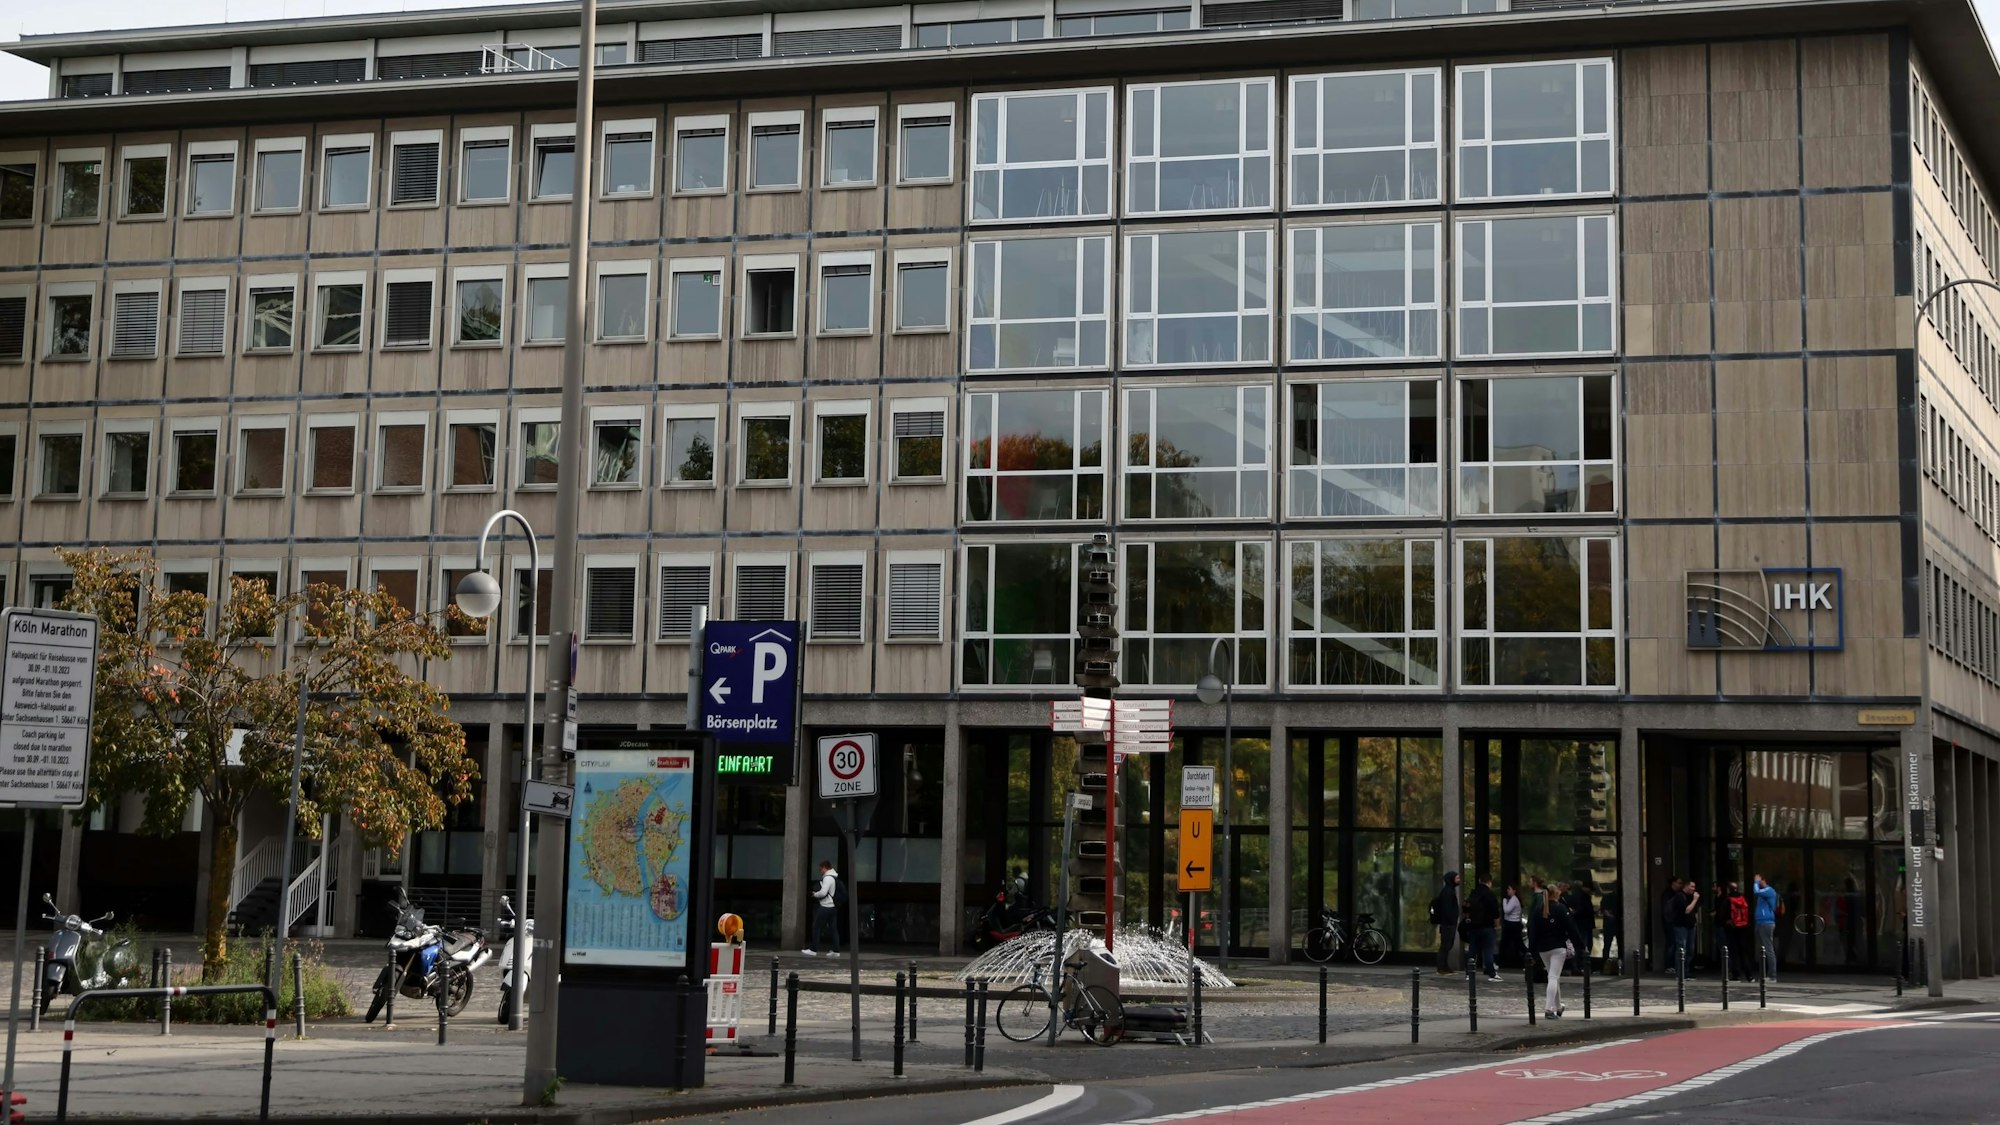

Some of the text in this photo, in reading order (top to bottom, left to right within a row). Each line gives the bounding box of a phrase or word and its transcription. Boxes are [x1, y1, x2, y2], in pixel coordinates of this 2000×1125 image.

[1774, 583, 1833, 610] IHK
[14, 619, 88, 638] Köln Marathon
[11, 650, 39, 661] Haltepunkt
[48, 653, 76, 662] Reisebusse
[751, 641, 788, 704] P
[12, 676, 35, 686] aufgrund
[36, 676, 60, 686] Marathon
[22, 688, 72, 699] Bitte fahren Sie den
[16, 713, 54, 723] Sachsenhausen
[61, 716, 76, 725] 50667
[707, 713, 778, 733] Börsenplatz
[22, 729, 66, 741] Coach parking lot
[13, 741, 30, 751] closed
[31, 742, 40, 751] due
[48, 743, 72, 752] marathon
[13, 754, 26, 763] from
[717, 754, 774, 773] EINFAHRT
[836, 750, 858, 769] 30
[17, 768, 26, 776] use
[27, 767, 36, 776] the
[62, 769, 73, 779] stop
[1186, 771, 1210, 780] Durchfahrt
[10, 779, 49, 789] Sachsenhausen
[834, 781, 862, 793] ZONE
[1184, 794, 1210, 804] gesperrt
[1192, 821, 1200, 839] U
[1908, 752, 1924, 927] Industrie- und elskammer
